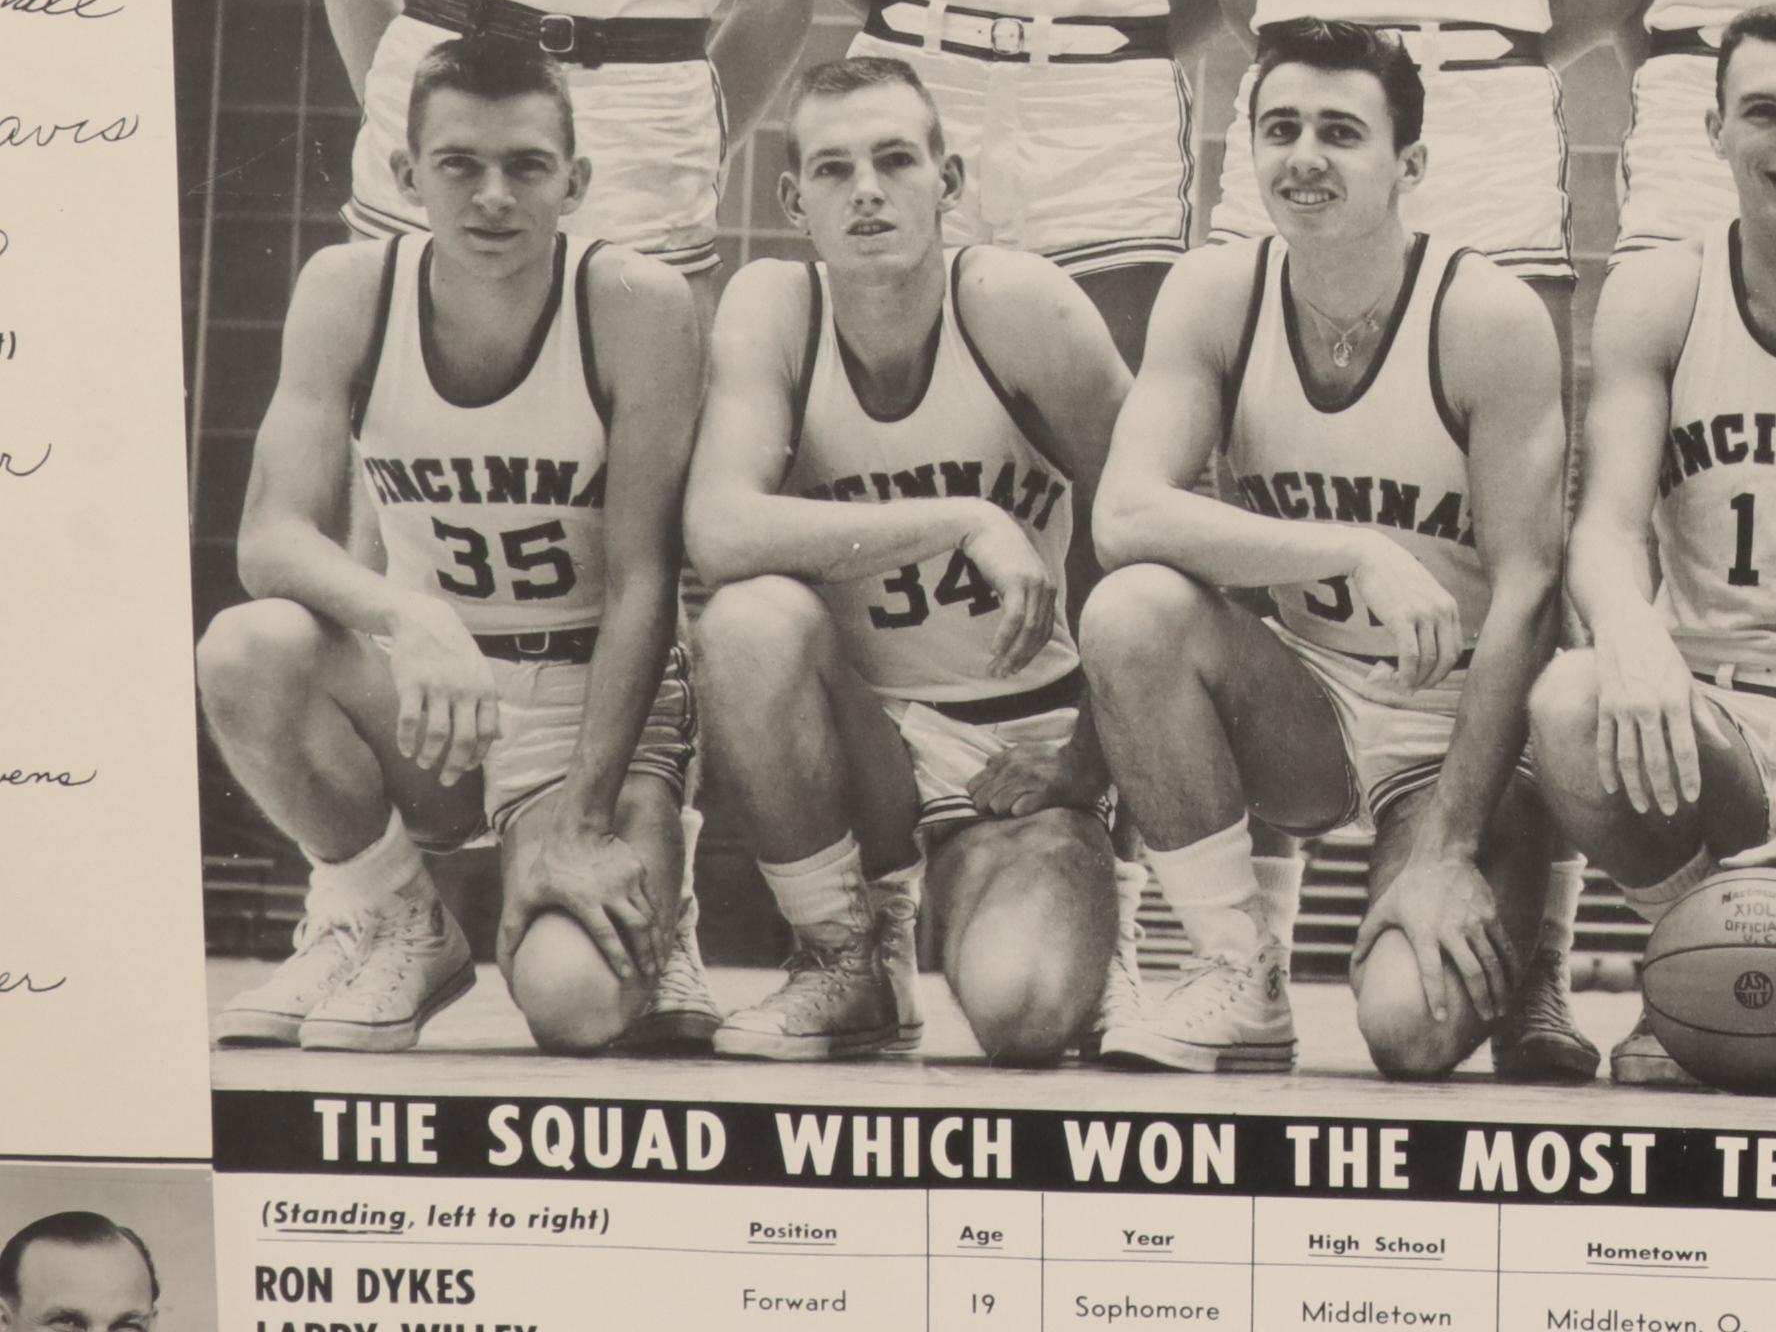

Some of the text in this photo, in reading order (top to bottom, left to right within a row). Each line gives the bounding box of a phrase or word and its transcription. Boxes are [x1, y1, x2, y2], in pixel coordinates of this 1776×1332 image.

[431, 516, 577, 601] 35
[868, 548, 1000, 629] 34
[314, 1100, 437, 1163] THE
[488, 1104, 727, 1170] SQUAD
[775, 1113, 1013, 1178] WHICH
[1064, 1121, 1235, 1184] WON
[1286, 1125, 1409, 1189] THE
[1459, 1130, 1656, 1194] MOST
[262, 1201, 609, 1234] (Standing, left to right)
[750, 1222, 837, 1239] Position
[960, 1226, 1003, 1244] Age
[1123, 1230, 1174, 1246] Year
[1309, 1234, 1445, 1254] High School
[1588, 1243, 1707, 1262] Hometown
[255, 1266, 475, 1305] RON DYKES
[743, 1289, 846, 1311] Forward
[972, 1294, 995, 1315] 19
[1076, 1296, 1219, 1324] Sophomore
[1302, 1301, 1451, 1326] Middletown
